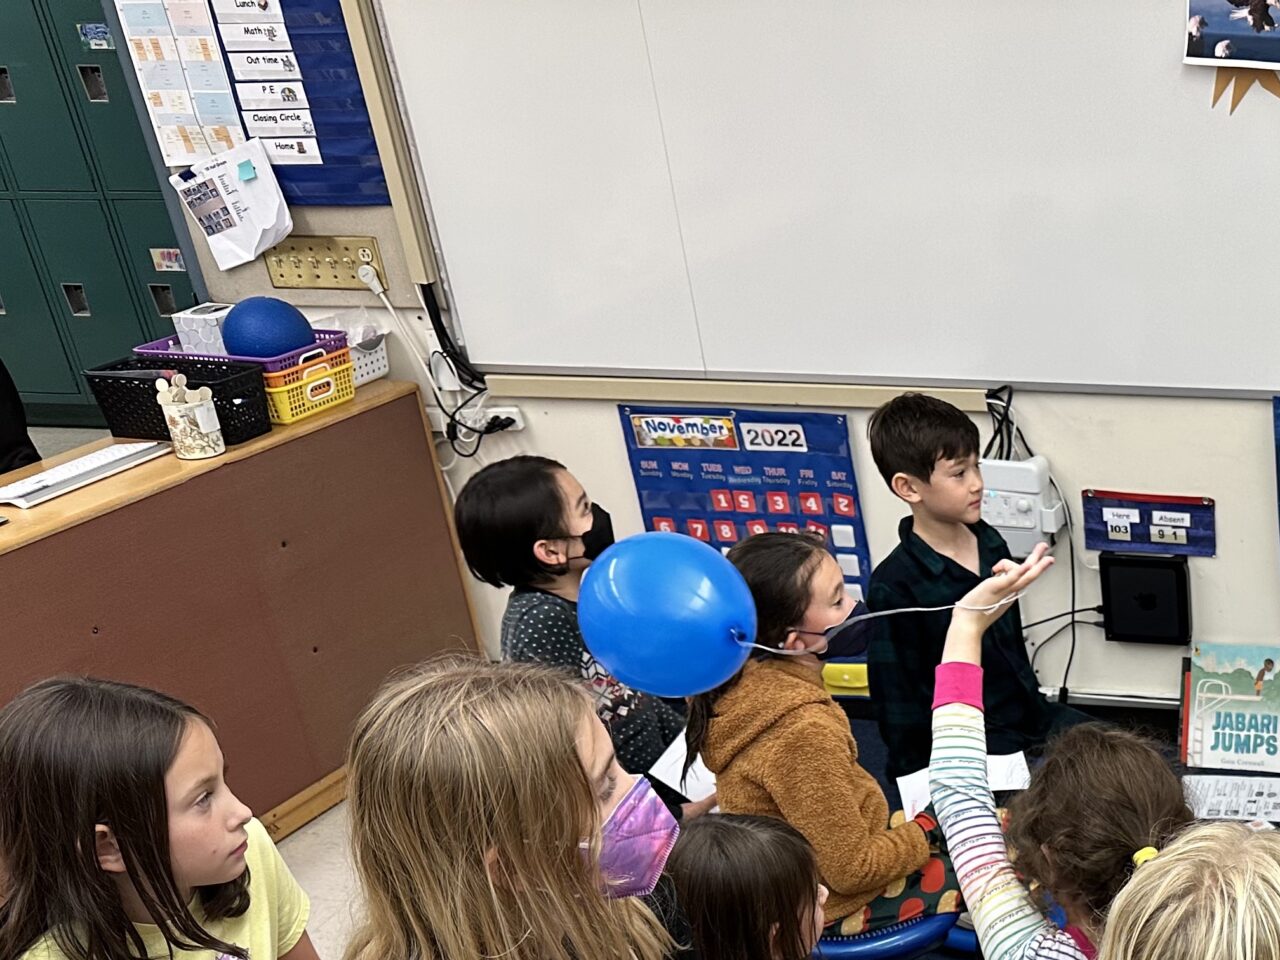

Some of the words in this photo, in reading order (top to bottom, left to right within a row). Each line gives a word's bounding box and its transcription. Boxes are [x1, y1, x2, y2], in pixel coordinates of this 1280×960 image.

[235, 0, 256, 8] Lunch
[244, 27, 262, 35] Math
[246, 56, 261, 64] Out
[263, 56, 279, 64] time
[252, 113, 278, 124] Closing
[279, 111, 301, 121] Circle
[275, 142, 295, 150] Home
[644, 419, 725, 437] November
[746, 428, 804, 448] 2022
[701, 463, 722, 473] TUES
[733, 465, 752, 475] WED
[763, 466, 787, 477] THUR
[800, 469, 814, 478] FRI
[717, 494, 727, 507] 1
[774, 496, 784, 510] 3
[806, 497, 818, 511] 4
[1112, 512, 1131, 520] Here
[1159, 515, 1184, 524] Absent
[693, 524, 702, 537] 7
[721, 526, 731, 537] 8
[1110, 525, 1129, 534] 103
[1212, 711, 1279, 735] JABARI
[1210, 731, 1279, 756] JUMPS
